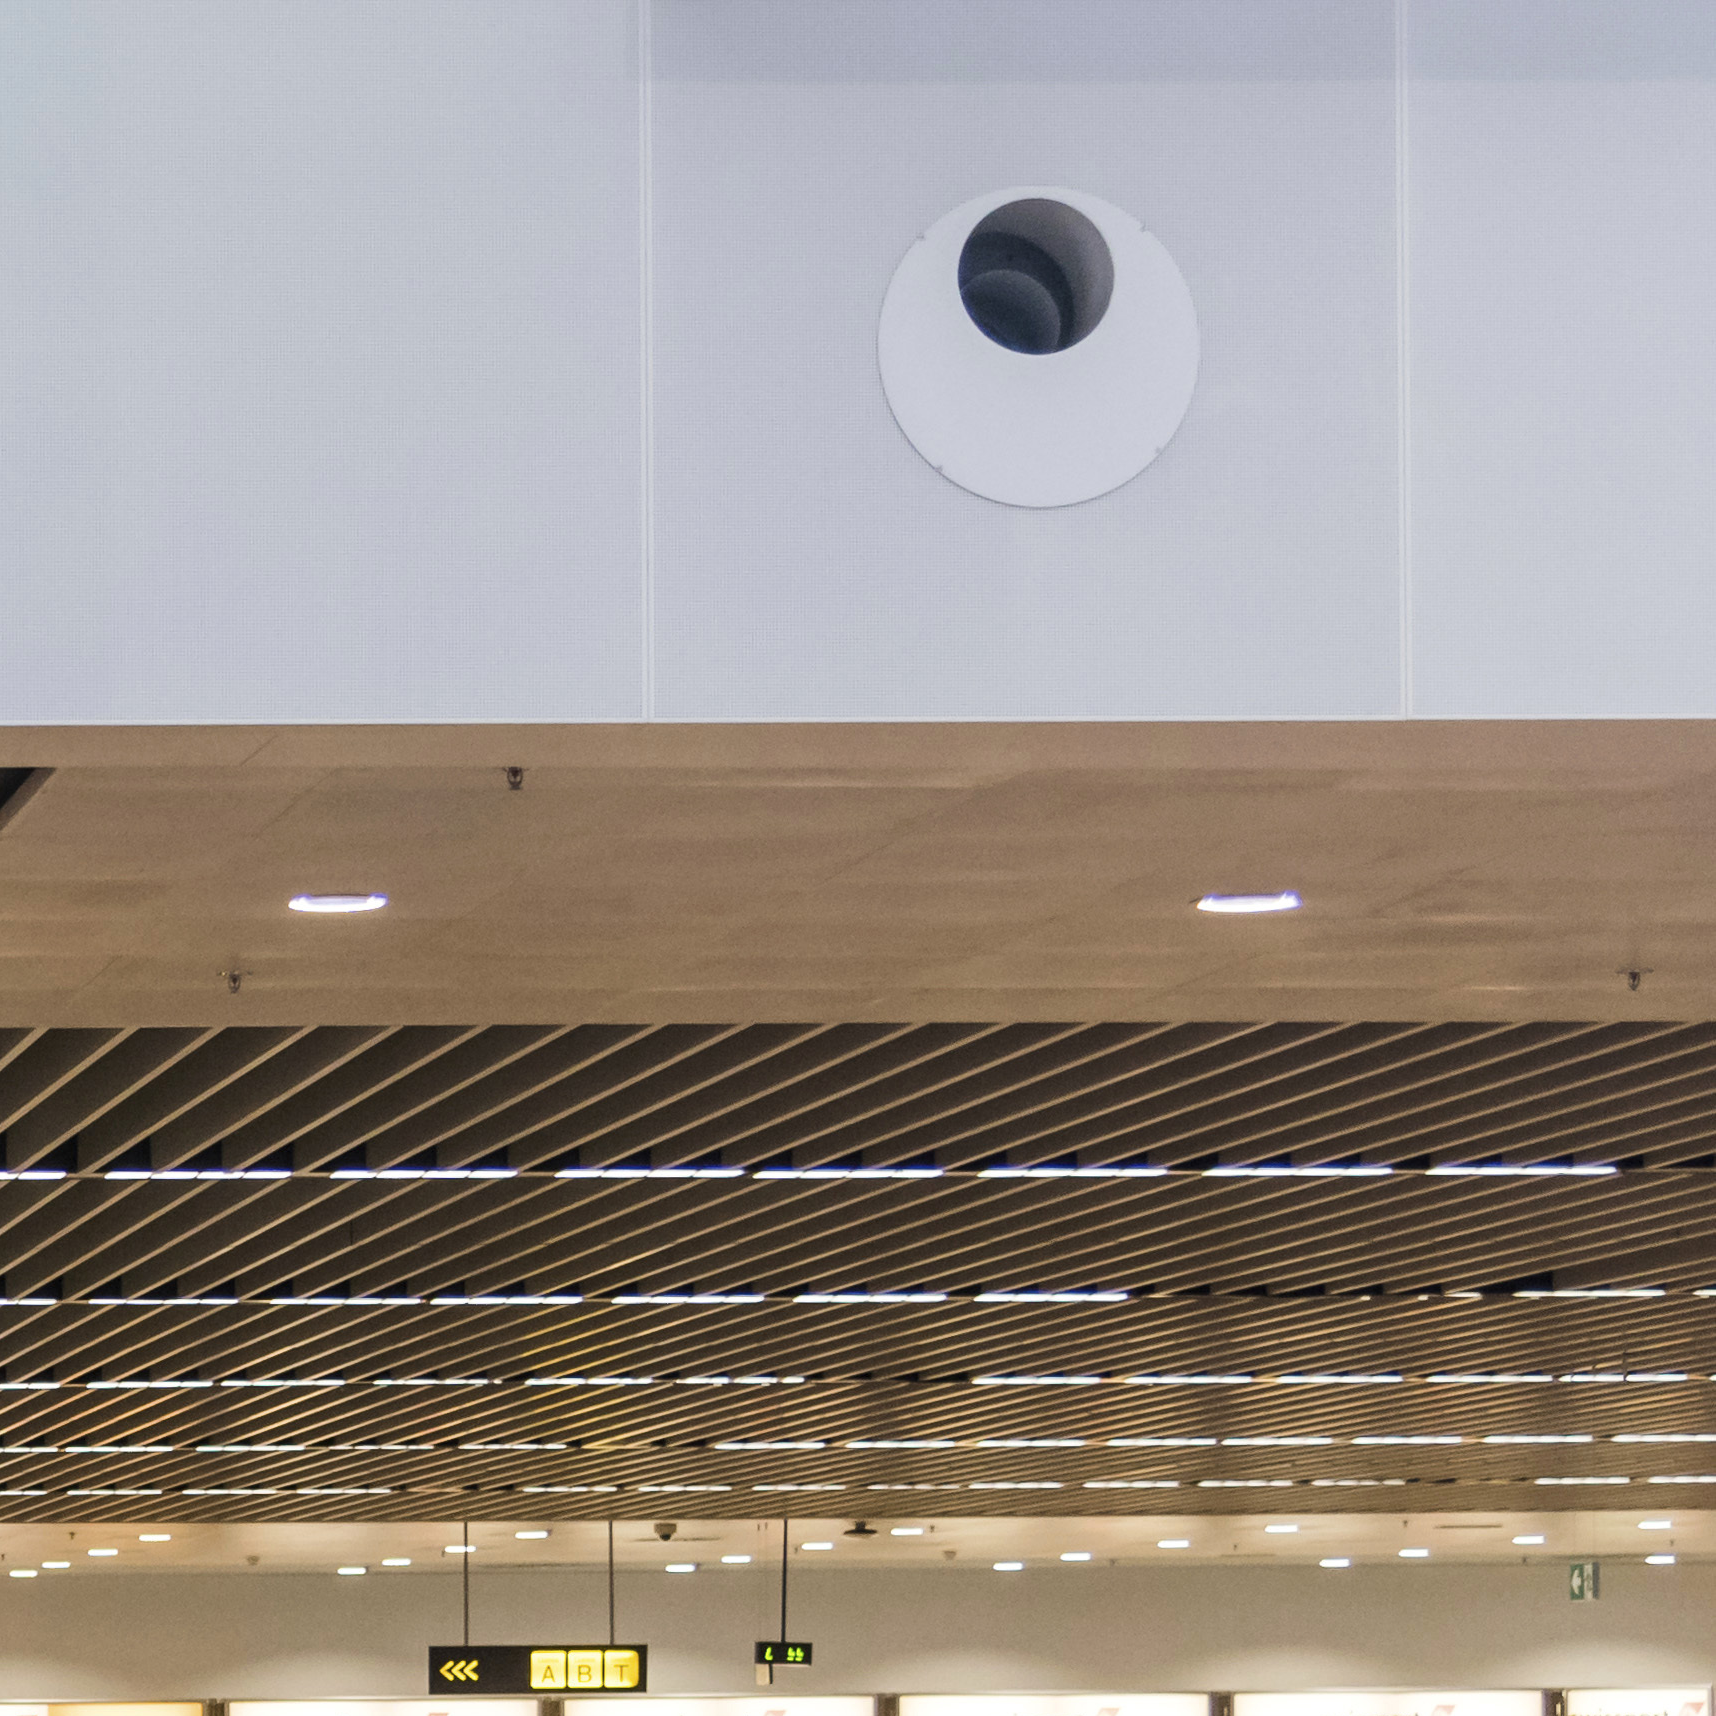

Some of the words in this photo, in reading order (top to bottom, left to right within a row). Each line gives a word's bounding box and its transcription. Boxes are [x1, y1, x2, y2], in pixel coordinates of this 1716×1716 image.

[541, 1665, 556, 1683] A
[578, 1665, 592, 1683] B
[615, 1664, 629, 1682] T
